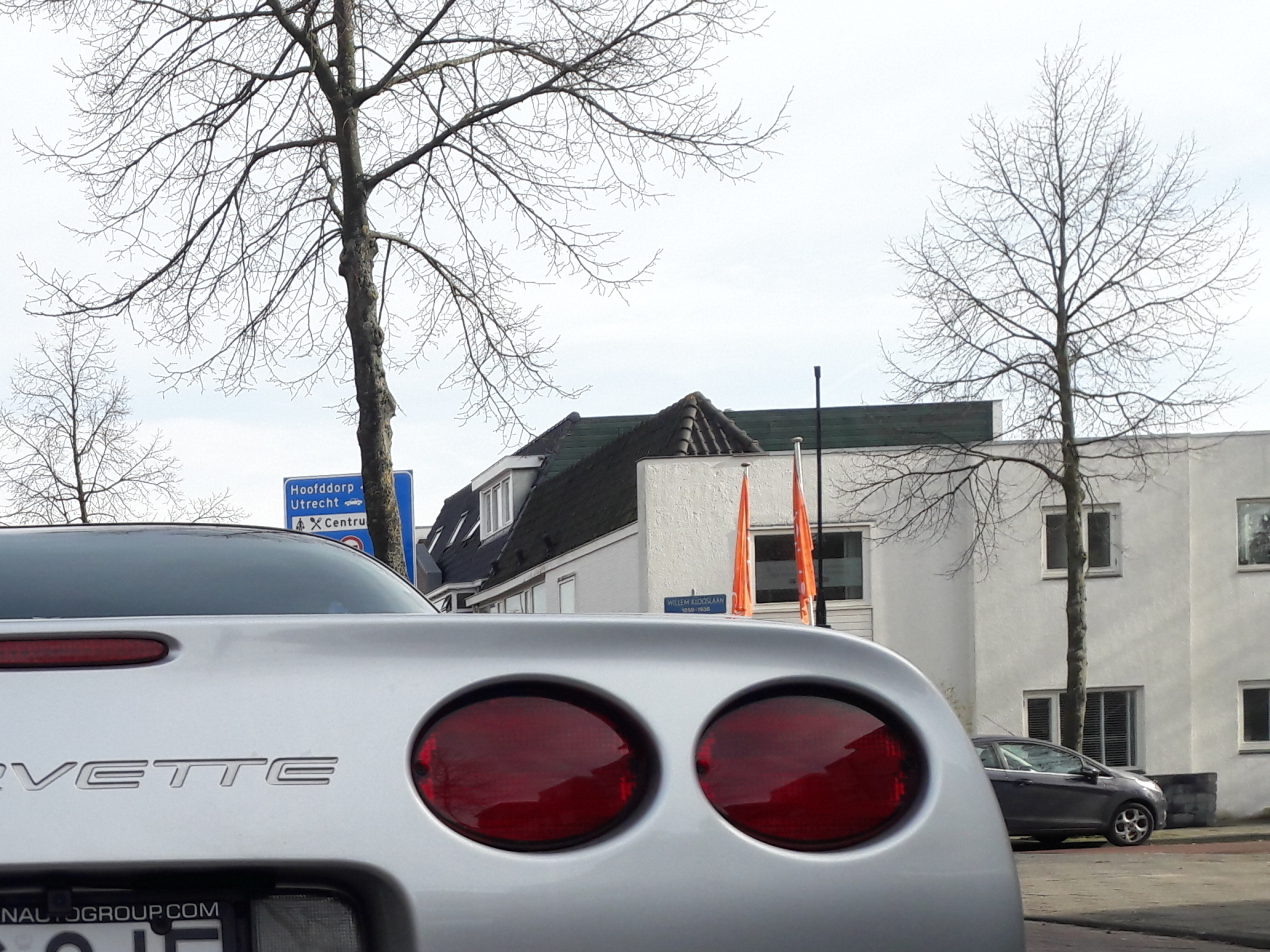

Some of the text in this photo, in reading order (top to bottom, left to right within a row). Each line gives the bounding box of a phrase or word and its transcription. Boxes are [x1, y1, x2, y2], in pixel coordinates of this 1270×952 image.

[290, 483, 354, 495] Hoofddorp
[290, 497, 340, 510] Utrecht
[325, 517, 367, 528] Centru
